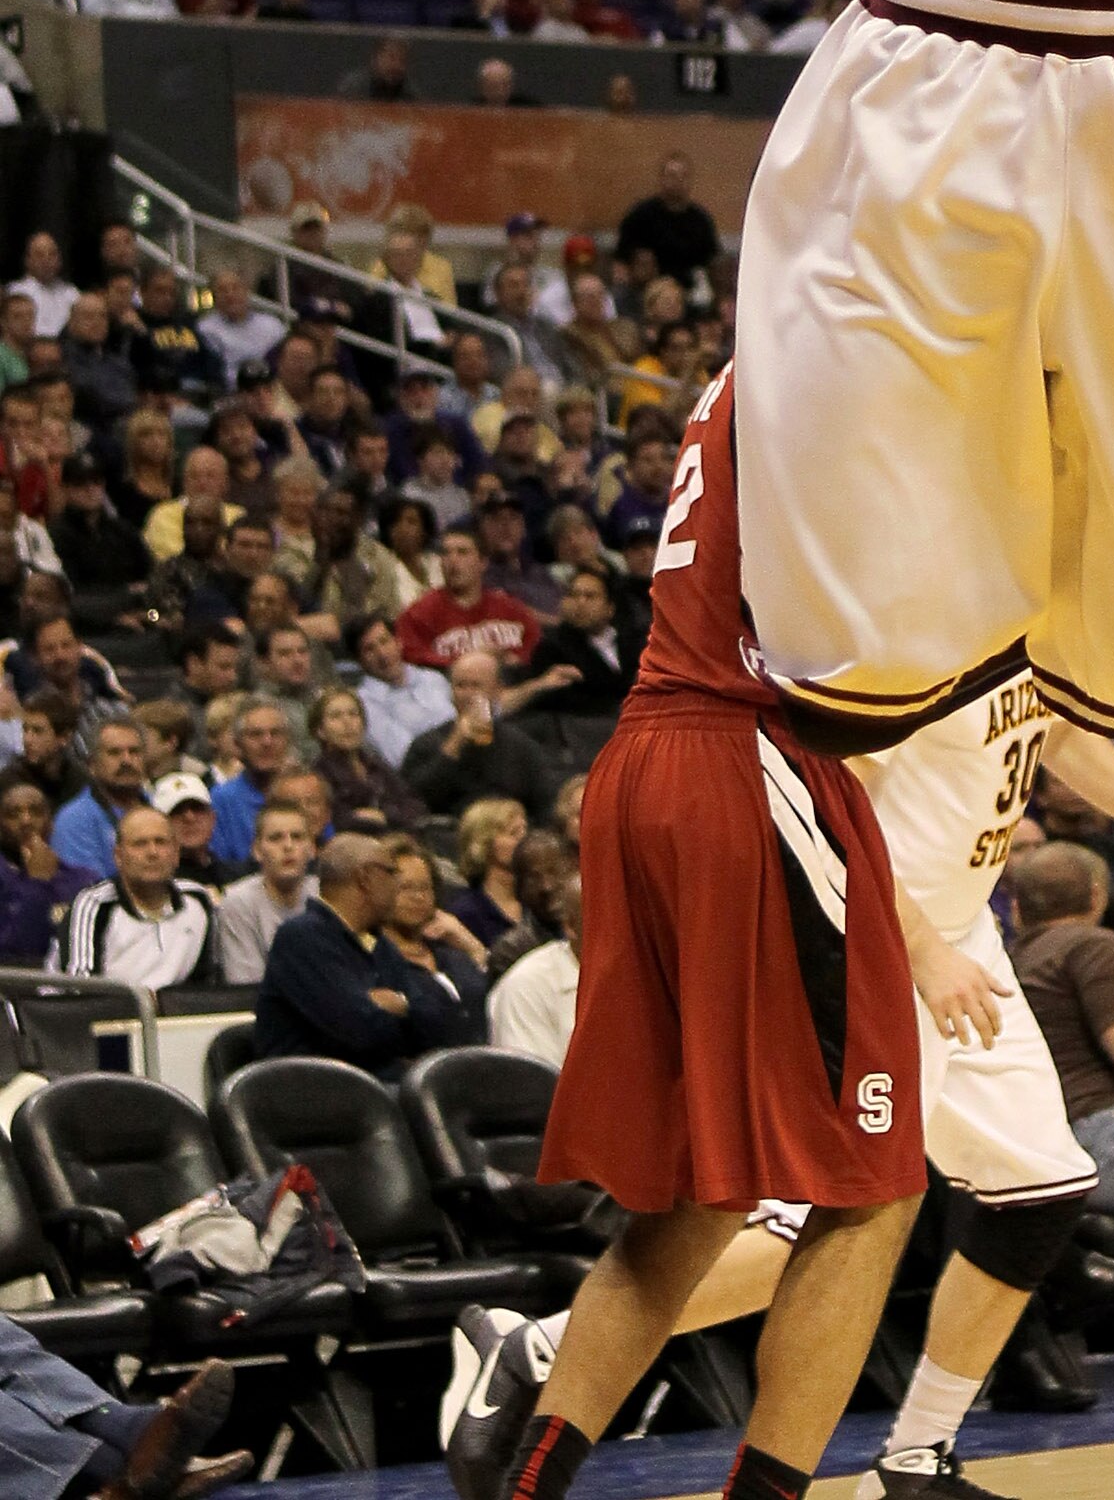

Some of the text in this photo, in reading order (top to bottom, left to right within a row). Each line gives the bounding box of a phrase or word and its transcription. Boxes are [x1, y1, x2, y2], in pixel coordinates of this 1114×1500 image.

[984, 680, 1052, 746] ARIZ
[996, 730, 1046, 815] 30
[857, 1072, 894, 1134] S
